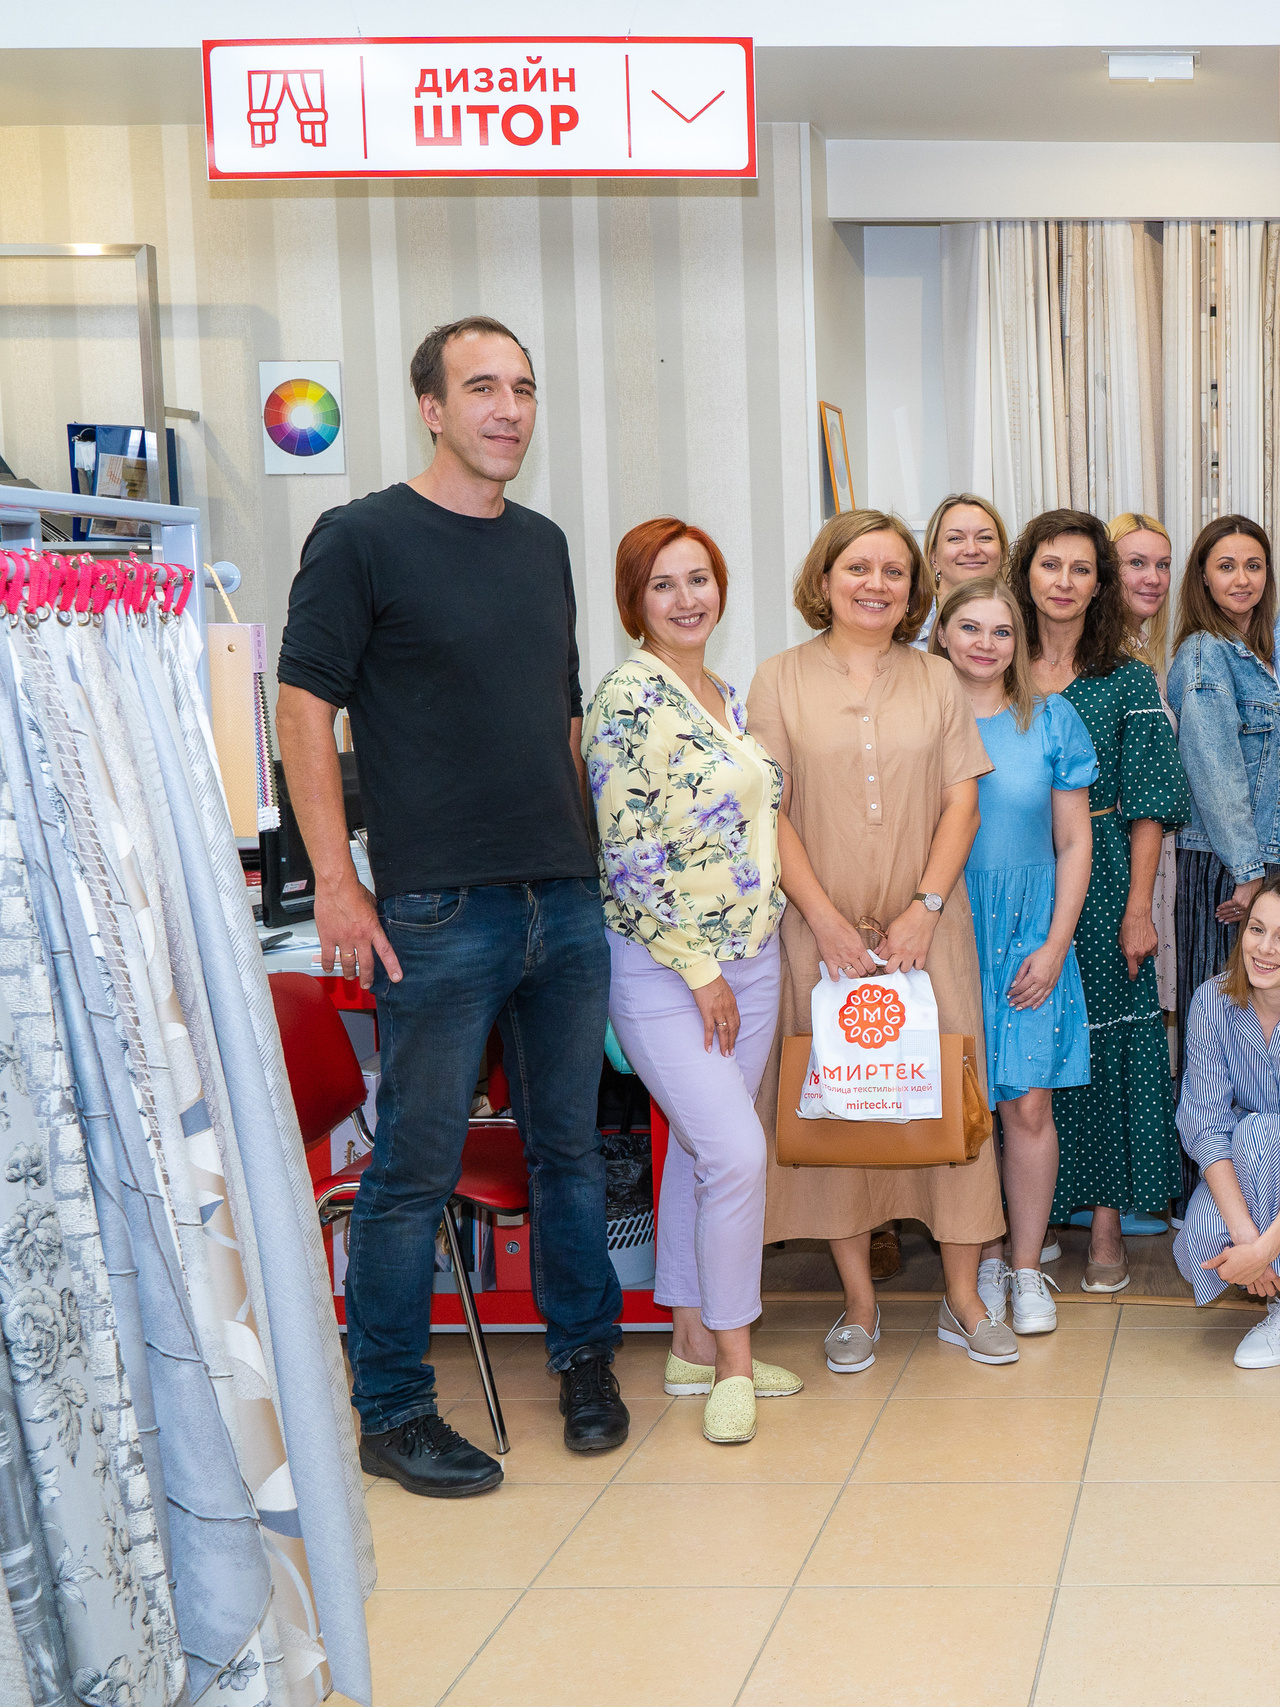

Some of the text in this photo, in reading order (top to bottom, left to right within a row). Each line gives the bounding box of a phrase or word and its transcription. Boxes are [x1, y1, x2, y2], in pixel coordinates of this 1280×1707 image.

[414, 55, 577, 98] дизайн
[413, 103, 580, 147] ШТОР
[822, 1063, 926, 1082] МИРТЕК
[853, 1083, 909, 1094] текстильных
[910, 1082, 933, 1093] идей
[846, 1099, 903, 1110] mirteck.ru
